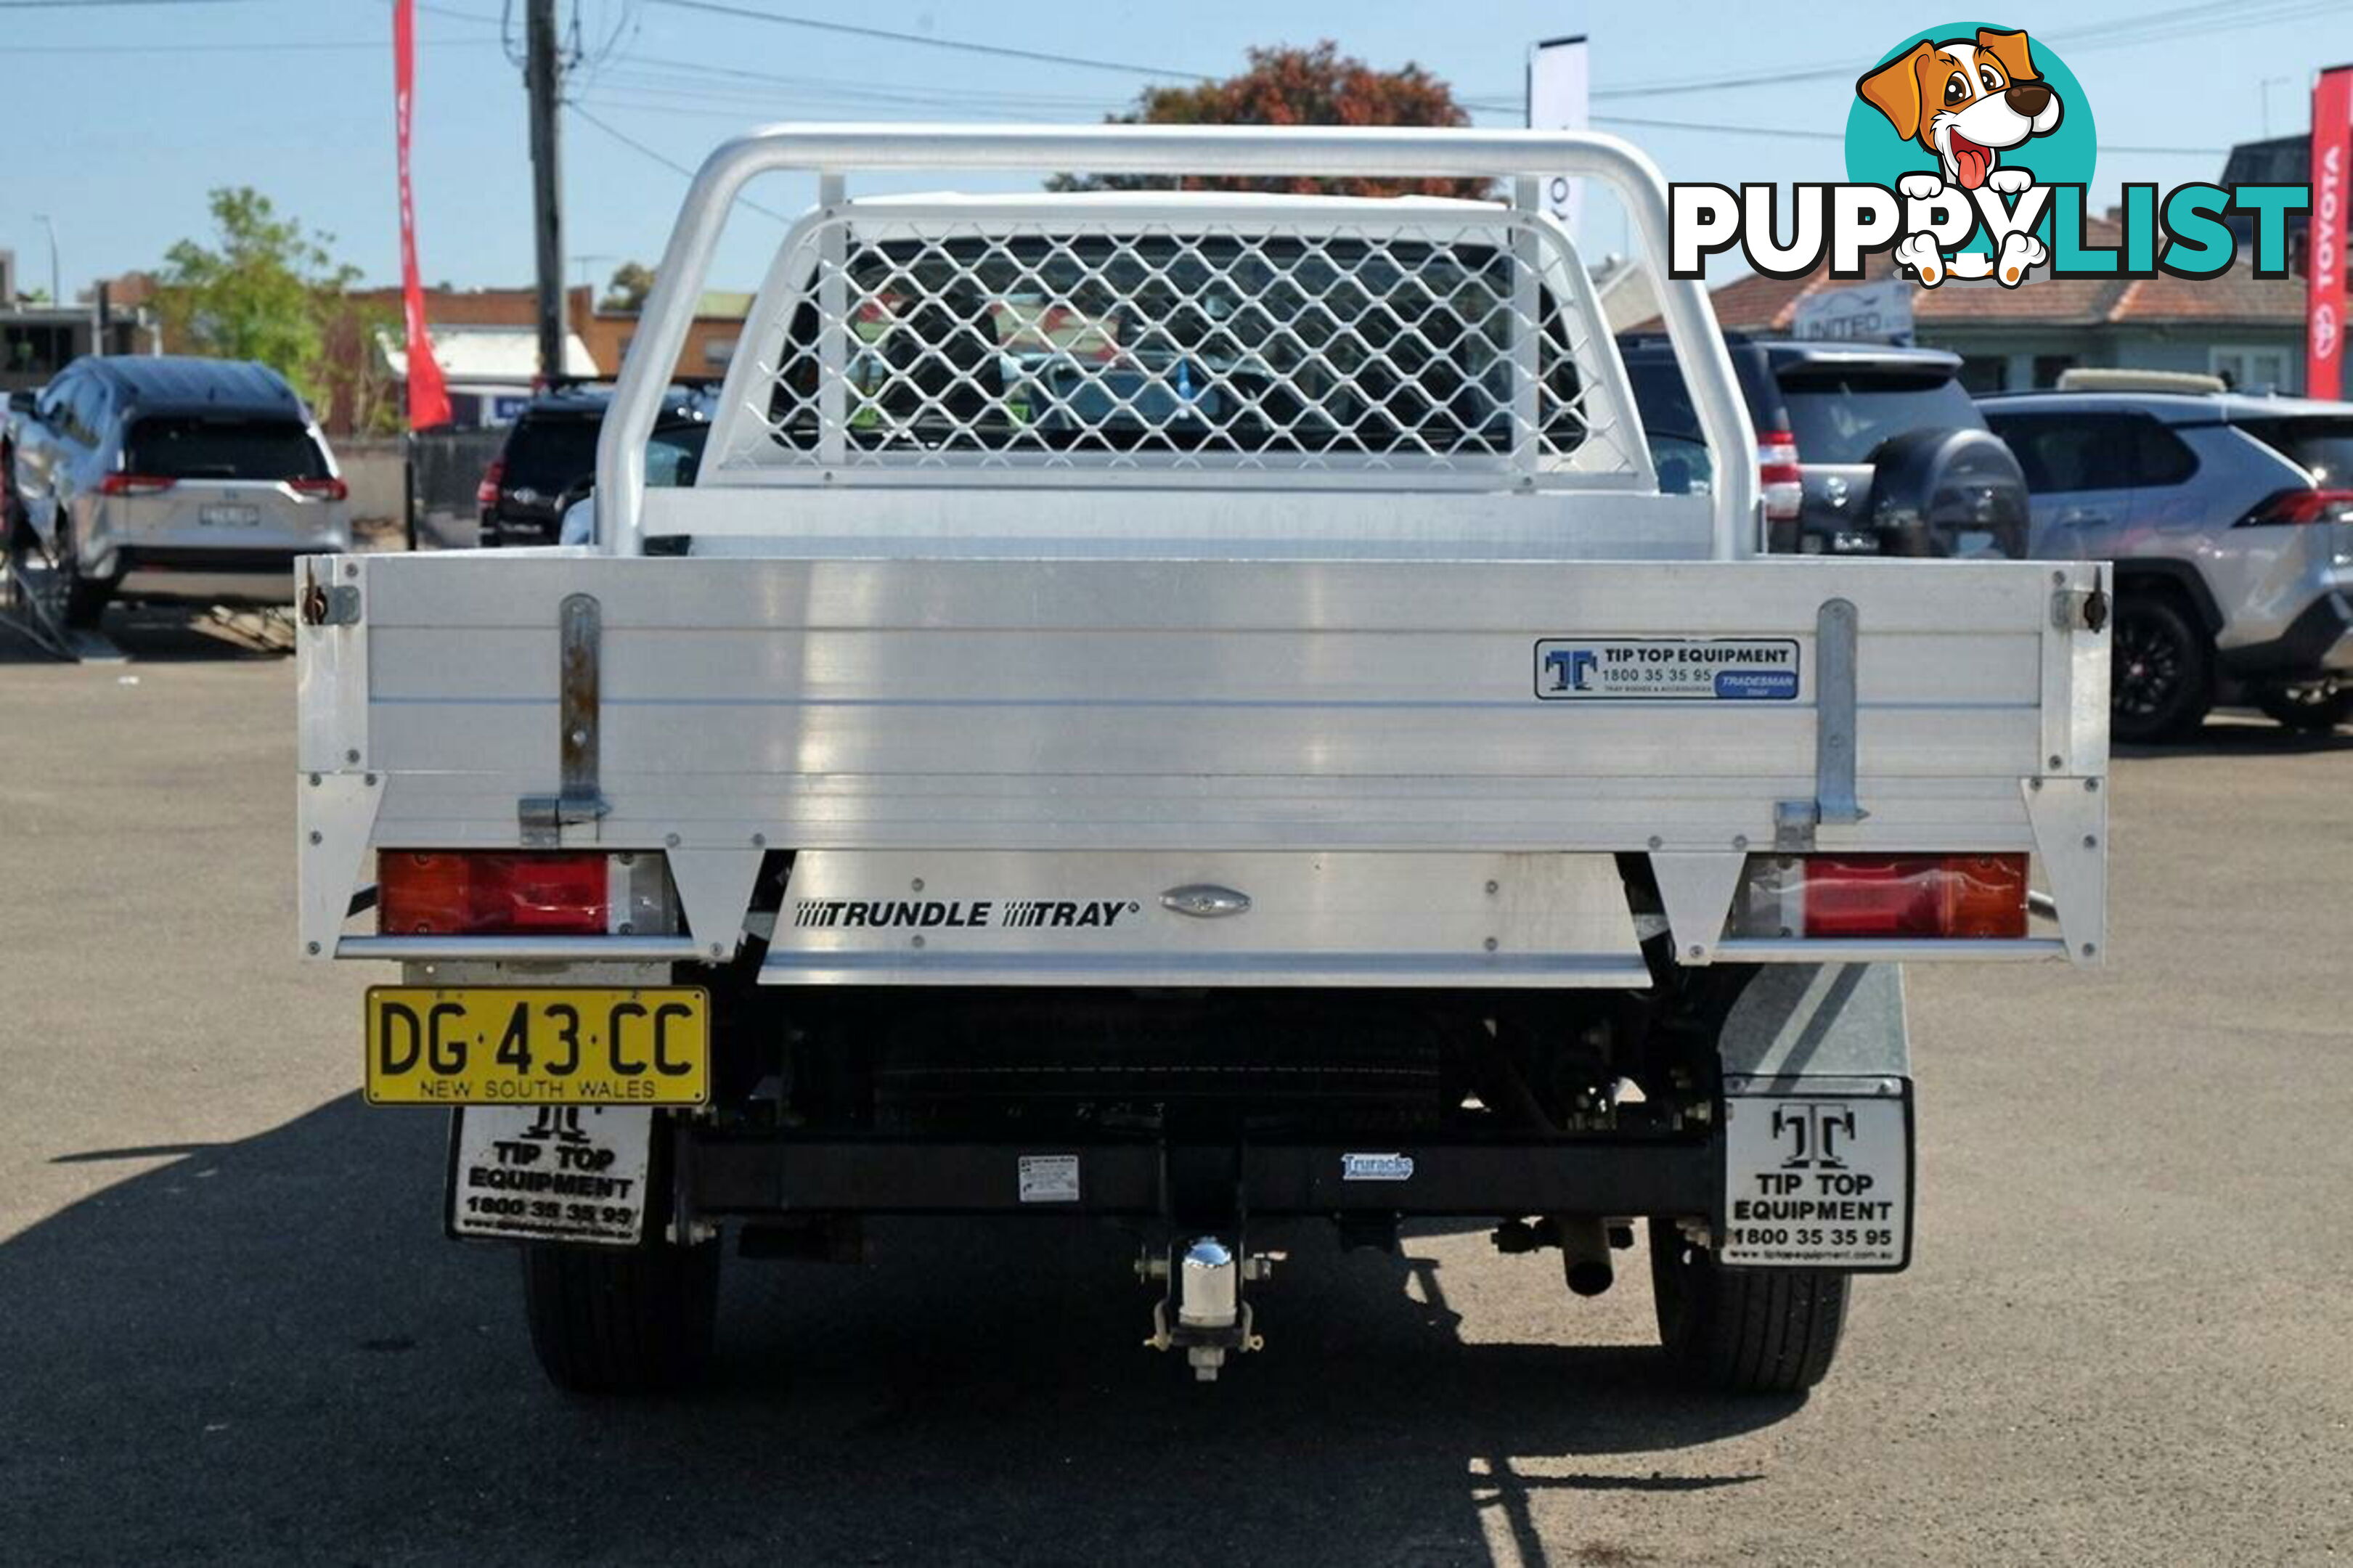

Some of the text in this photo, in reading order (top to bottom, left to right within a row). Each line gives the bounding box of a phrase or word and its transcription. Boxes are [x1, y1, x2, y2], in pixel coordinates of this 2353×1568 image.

[2317, 146, 2341, 293] TOYOTA
[1605, 648, 1789, 663] TIP TOP EQUIPMENT
[1603, 668, 1711, 681] 1800 35 35 95
[1721, 676, 1795, 687] TRADESMAN
[826, 902, 992, 926] TRUNDLE
[420, 1081, 655, 1098] NEW SOUTH WALES
[493, 1140, 615, 1172] TIP TOP
[1345, 1155, 1411, 1172] Truracks
[468, 1167, 634, 1200] EQUIPMENT
[1755, 1174, 1874, 1196] TIP TOP
[467, 1196, 526, 1215] 1800
[1733, 1201, 1892, 1221] EQUIPMENT
[1735, 1228, 1892, 1246] 1800 35 35 95
